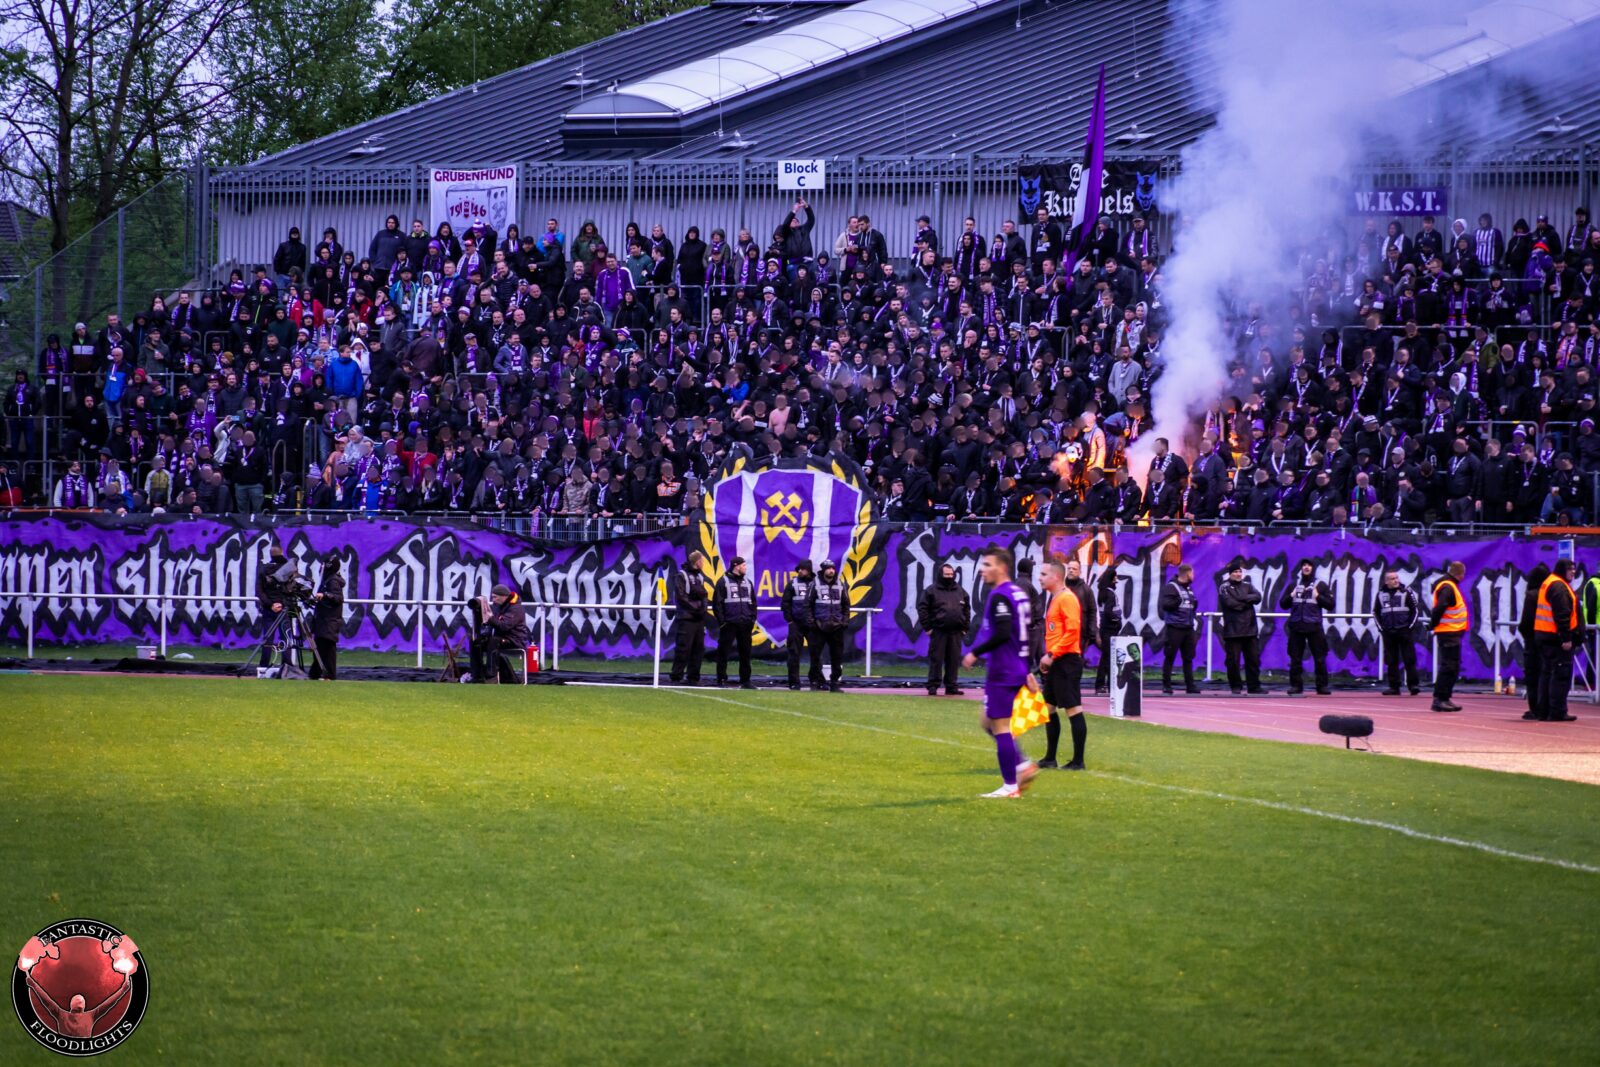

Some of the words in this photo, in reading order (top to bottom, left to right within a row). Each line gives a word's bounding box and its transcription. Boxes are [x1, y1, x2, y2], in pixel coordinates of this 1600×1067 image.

[434, 167, 515, 182] GRUBENHUND
[784, 162, 818, 174] Block
[797, 175, 806, 187] C
[1044, 187, 1135, 217] Kuels
[1355, 191, 1441, 212] W.K.S.T.
